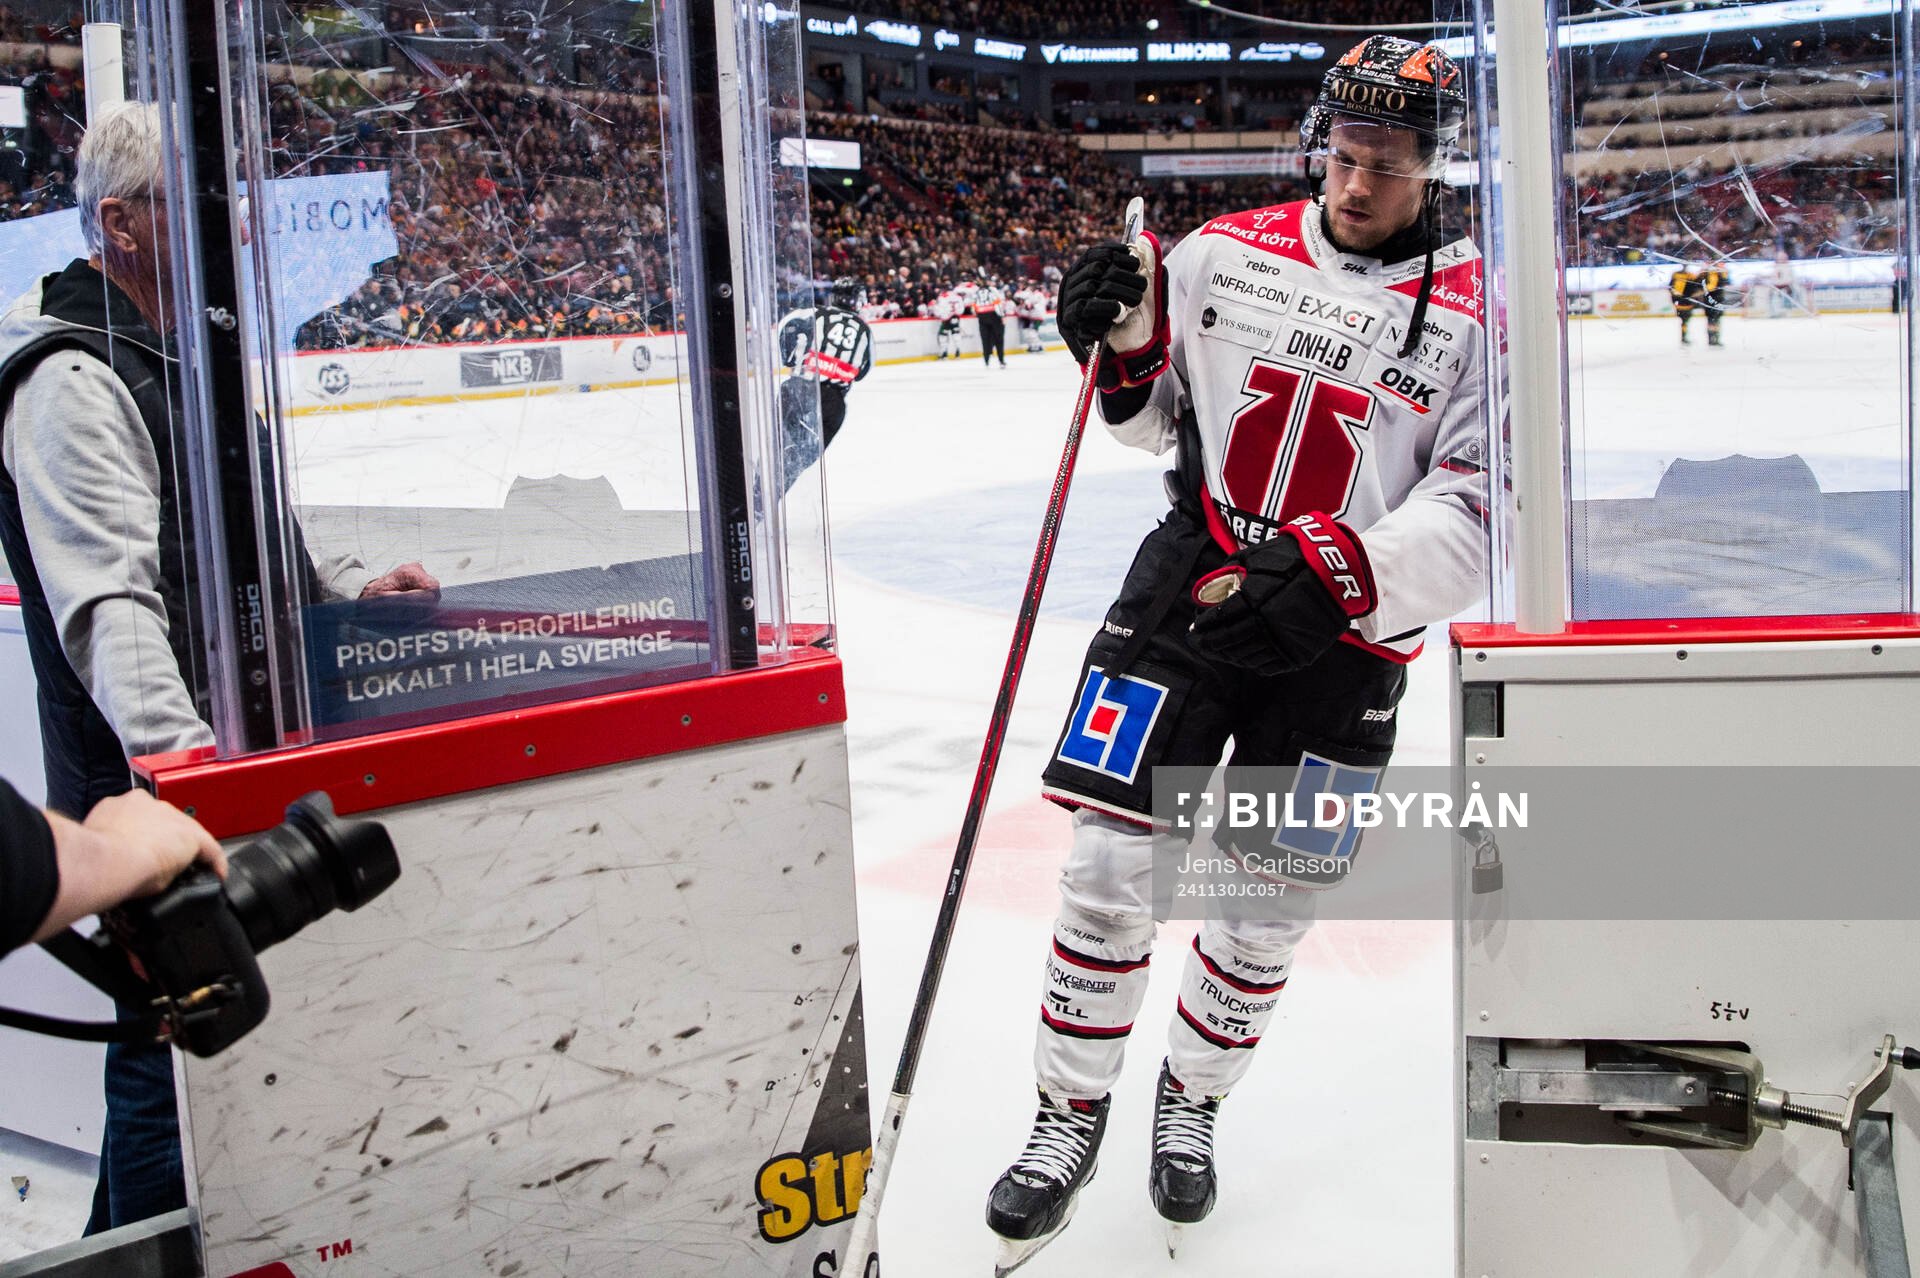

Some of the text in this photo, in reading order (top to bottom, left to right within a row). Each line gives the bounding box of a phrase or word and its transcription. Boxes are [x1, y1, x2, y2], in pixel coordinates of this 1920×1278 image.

[1330, 79, 1405, 111] MOFO
[1210, 222, 1298, 249] NÄRKE KÖTT
[1341, 262, 1368, 275] SHL
[1212, 273, 1289, 305] INFRA-CON
[1236, 322, 1273, 339] SERVICE
[1298, 295, 1376, 334] EXACT
[827, 323, 858, 350] 43
[1386, 326, 1461, 373] NSTA
[1380, 367, 1439, 407] OBK
[737, 521, 751, 582] DACO
[246, 583, 265, 651] DACO
[336, 597, 675, 668] PROFFS PÅ PROFILERING
[346, 630, 673, 701] LOKALT I HELA SVERIGE
[1072, 976, 1116, 989] CENTER
[1200, 976, 1253, 1014] TRUCK
[316, 1238, 352, 1262] TM
